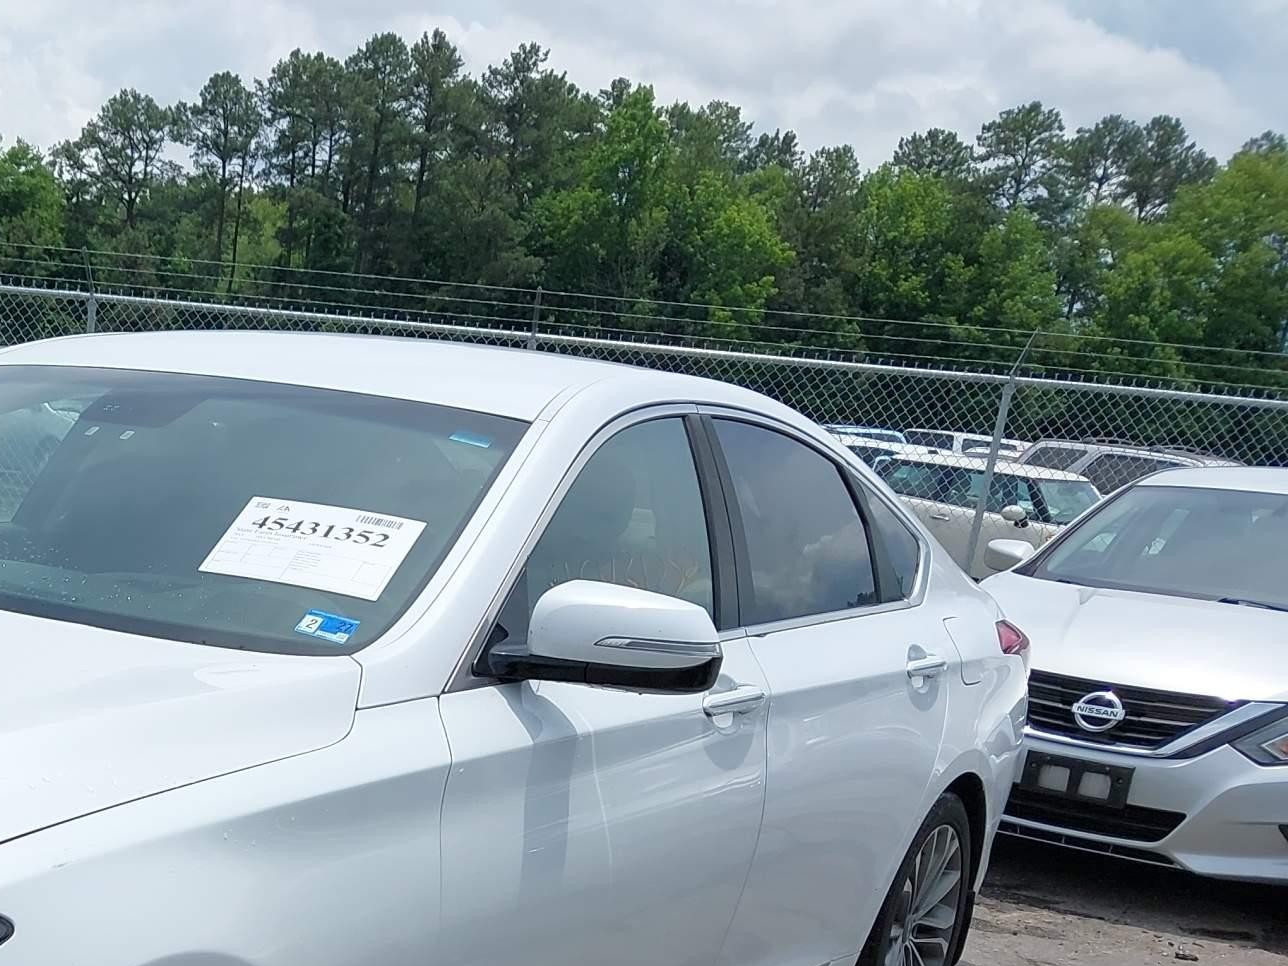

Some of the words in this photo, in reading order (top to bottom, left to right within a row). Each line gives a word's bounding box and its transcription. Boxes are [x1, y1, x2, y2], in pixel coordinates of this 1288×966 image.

[252, 515, 390, 548] 45431352
[305, 617, 319, 630] 2
[336, 619, 355, 634] 27
[1076, 705, 1119, 718] NISSAN
